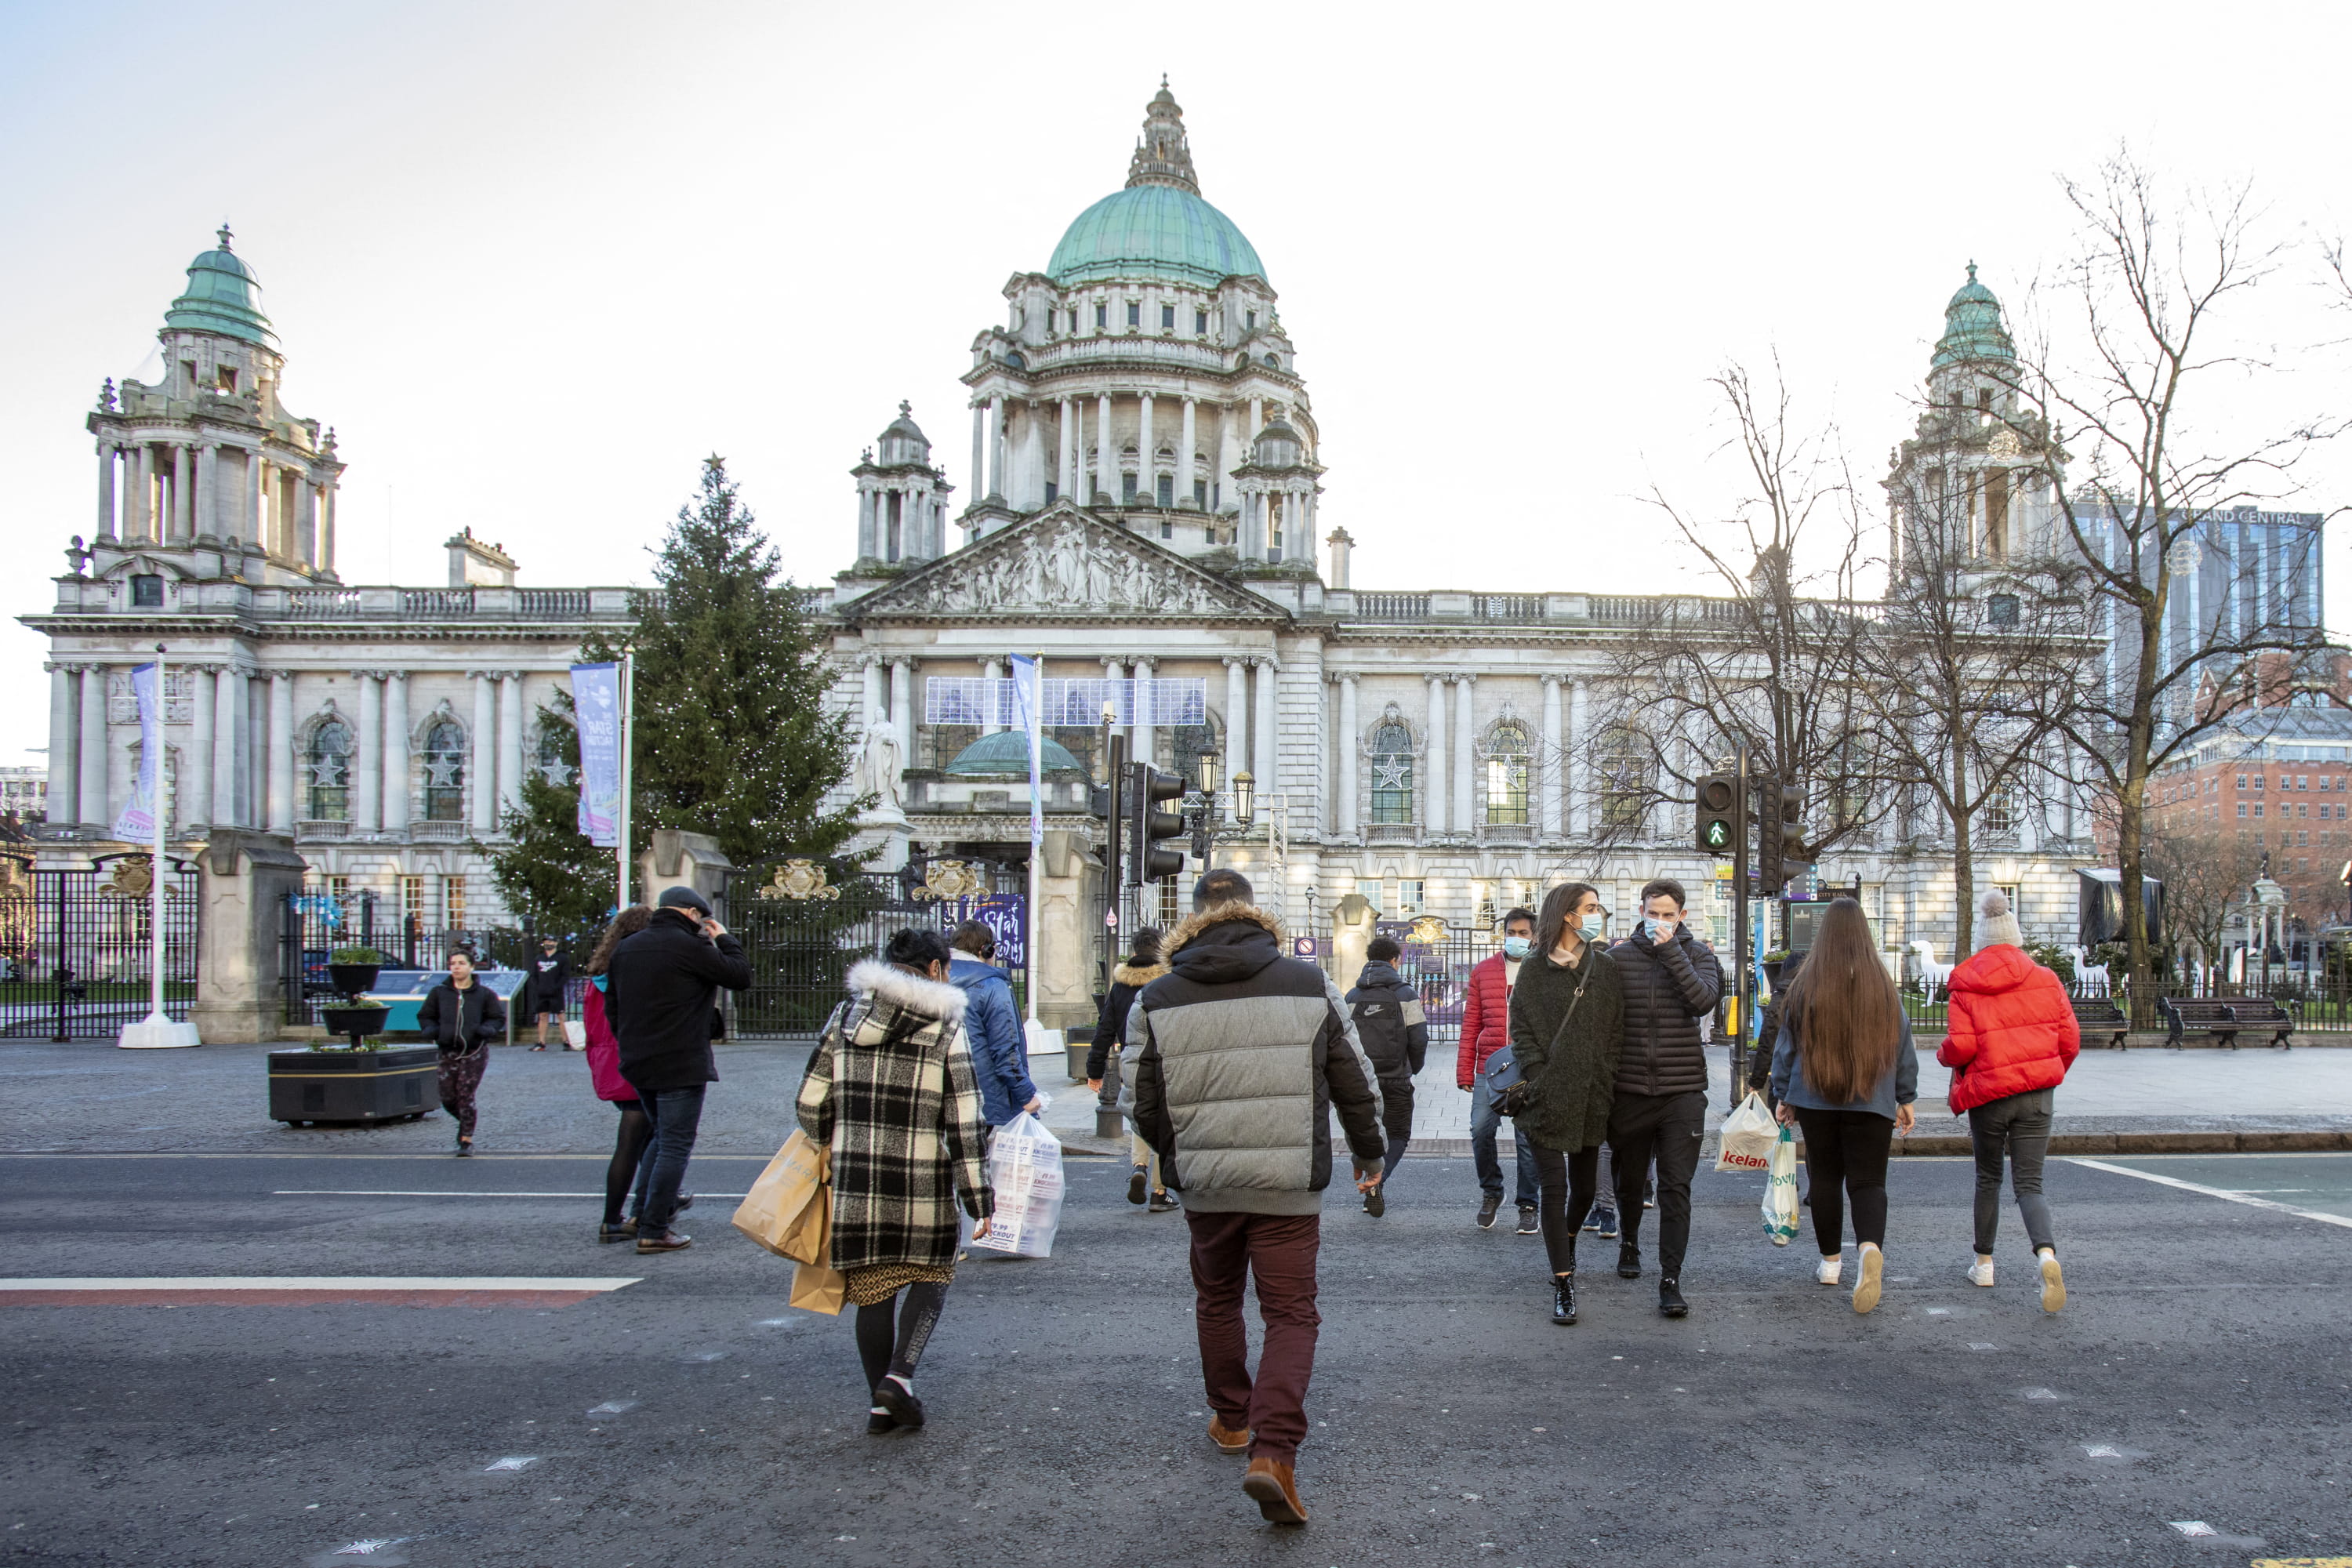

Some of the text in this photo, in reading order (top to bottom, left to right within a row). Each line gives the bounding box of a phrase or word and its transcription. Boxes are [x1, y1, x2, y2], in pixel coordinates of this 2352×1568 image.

[2238, 511, 2303, 524] CENTRAL
[1723, 1150, 1769, 1167] Icelan
[771, 1153, 818, 1185] PMARK
[991, 1230, 1015, 1240] CKOUT
